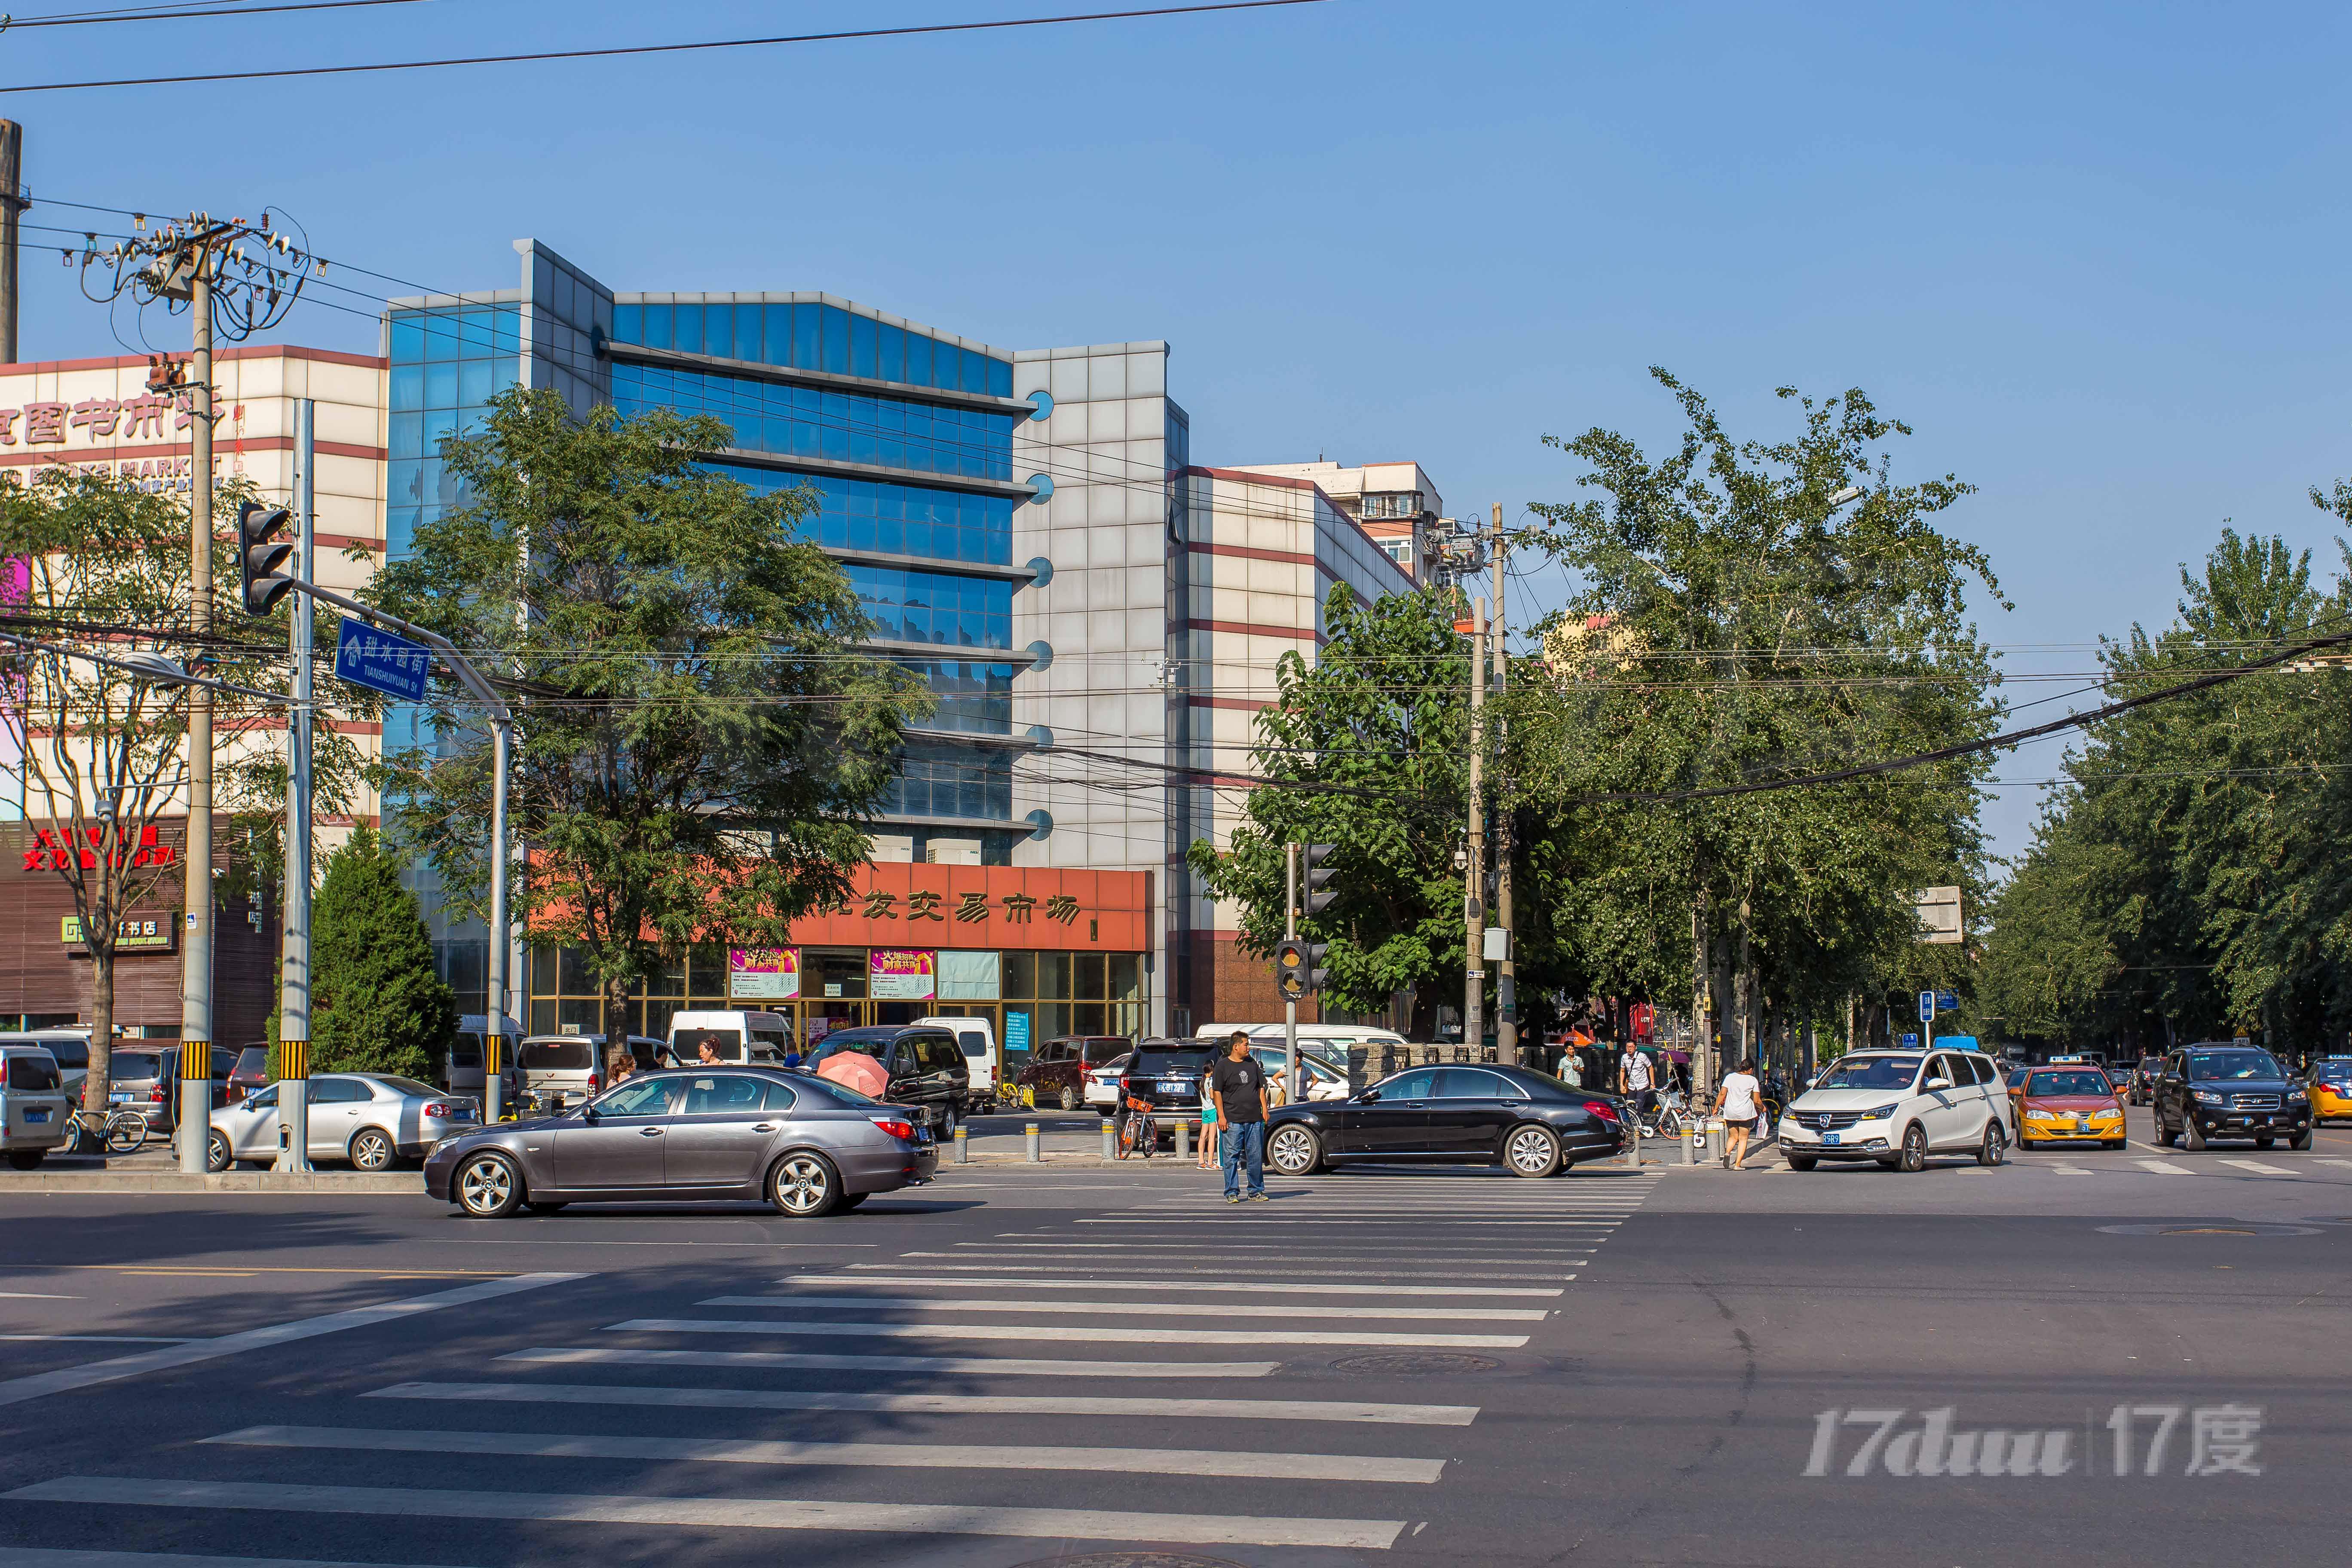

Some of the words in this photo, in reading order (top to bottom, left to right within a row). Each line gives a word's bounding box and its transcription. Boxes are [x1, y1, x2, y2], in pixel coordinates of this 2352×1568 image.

[121, 456, 220, 477] MARKT
[365, 636, 424, 675] 甜水园街
[364, 665, 409, 689] TIANSHUIYUAN
[410, 682, 417, 693] St
